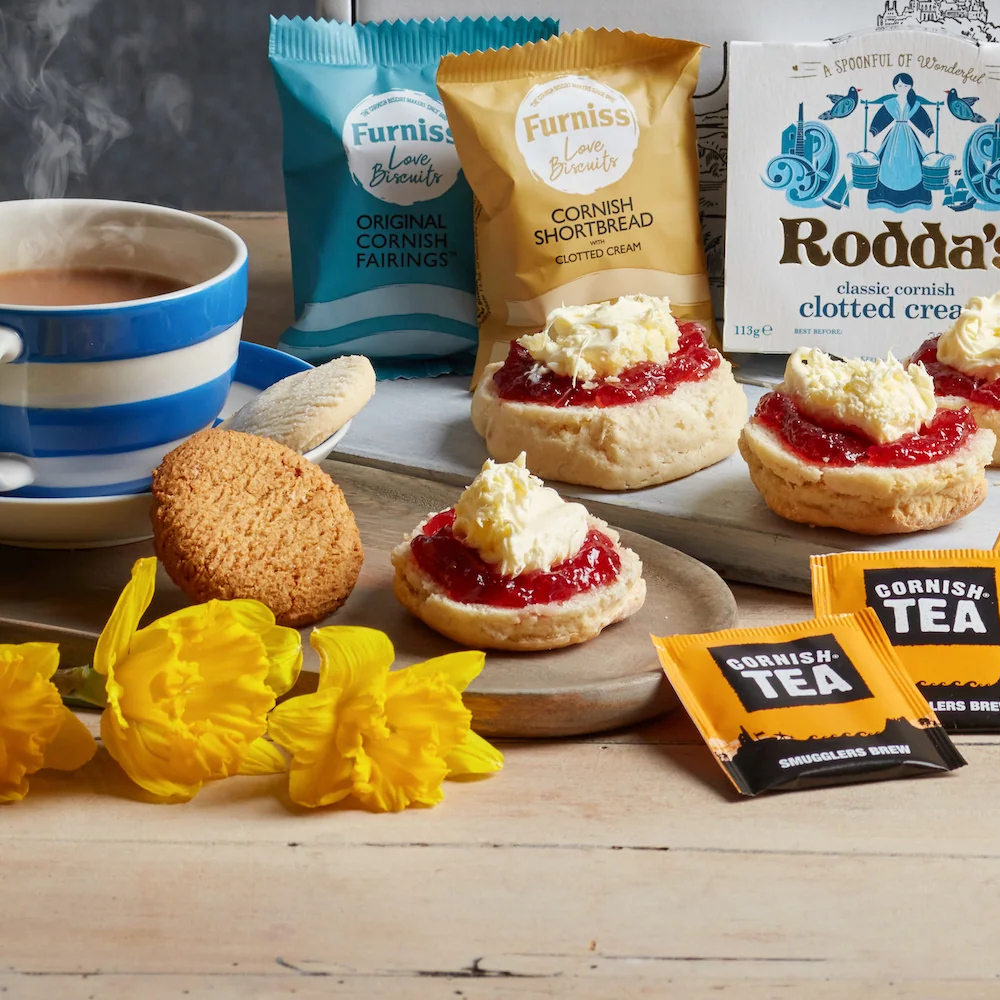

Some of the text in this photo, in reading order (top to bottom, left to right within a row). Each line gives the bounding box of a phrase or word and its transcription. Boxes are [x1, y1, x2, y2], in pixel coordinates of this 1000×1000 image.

[823, 53, 987, 85] A SPOONFUL OF Wonderful
[523, 103, 631, 143] Furniss
[388, 145, 433, 170] Love
[564, 136, 605, 161] Love
[369, 163, 443, 188] Biscuits
[549, 150, 619, 182] Biscuits
[356, 214, 447, 230] ORIGINAL
[551, 197, 634, 224] CORNISH
[356, 233, 448, 249] CORNISH
[534, 212, 654, 246] SHORTBREAD
[555, 242, 642, 265] CLOTTED CREAM
[837, 281, 955, 297] classic cornish
[799, 296, 962, 320] clotted crea
[883, 598, 988, 634] TEA
[741, 664, 853, 700] TEA
[778, 743, 912, 770] SMUGGLERS BREW
